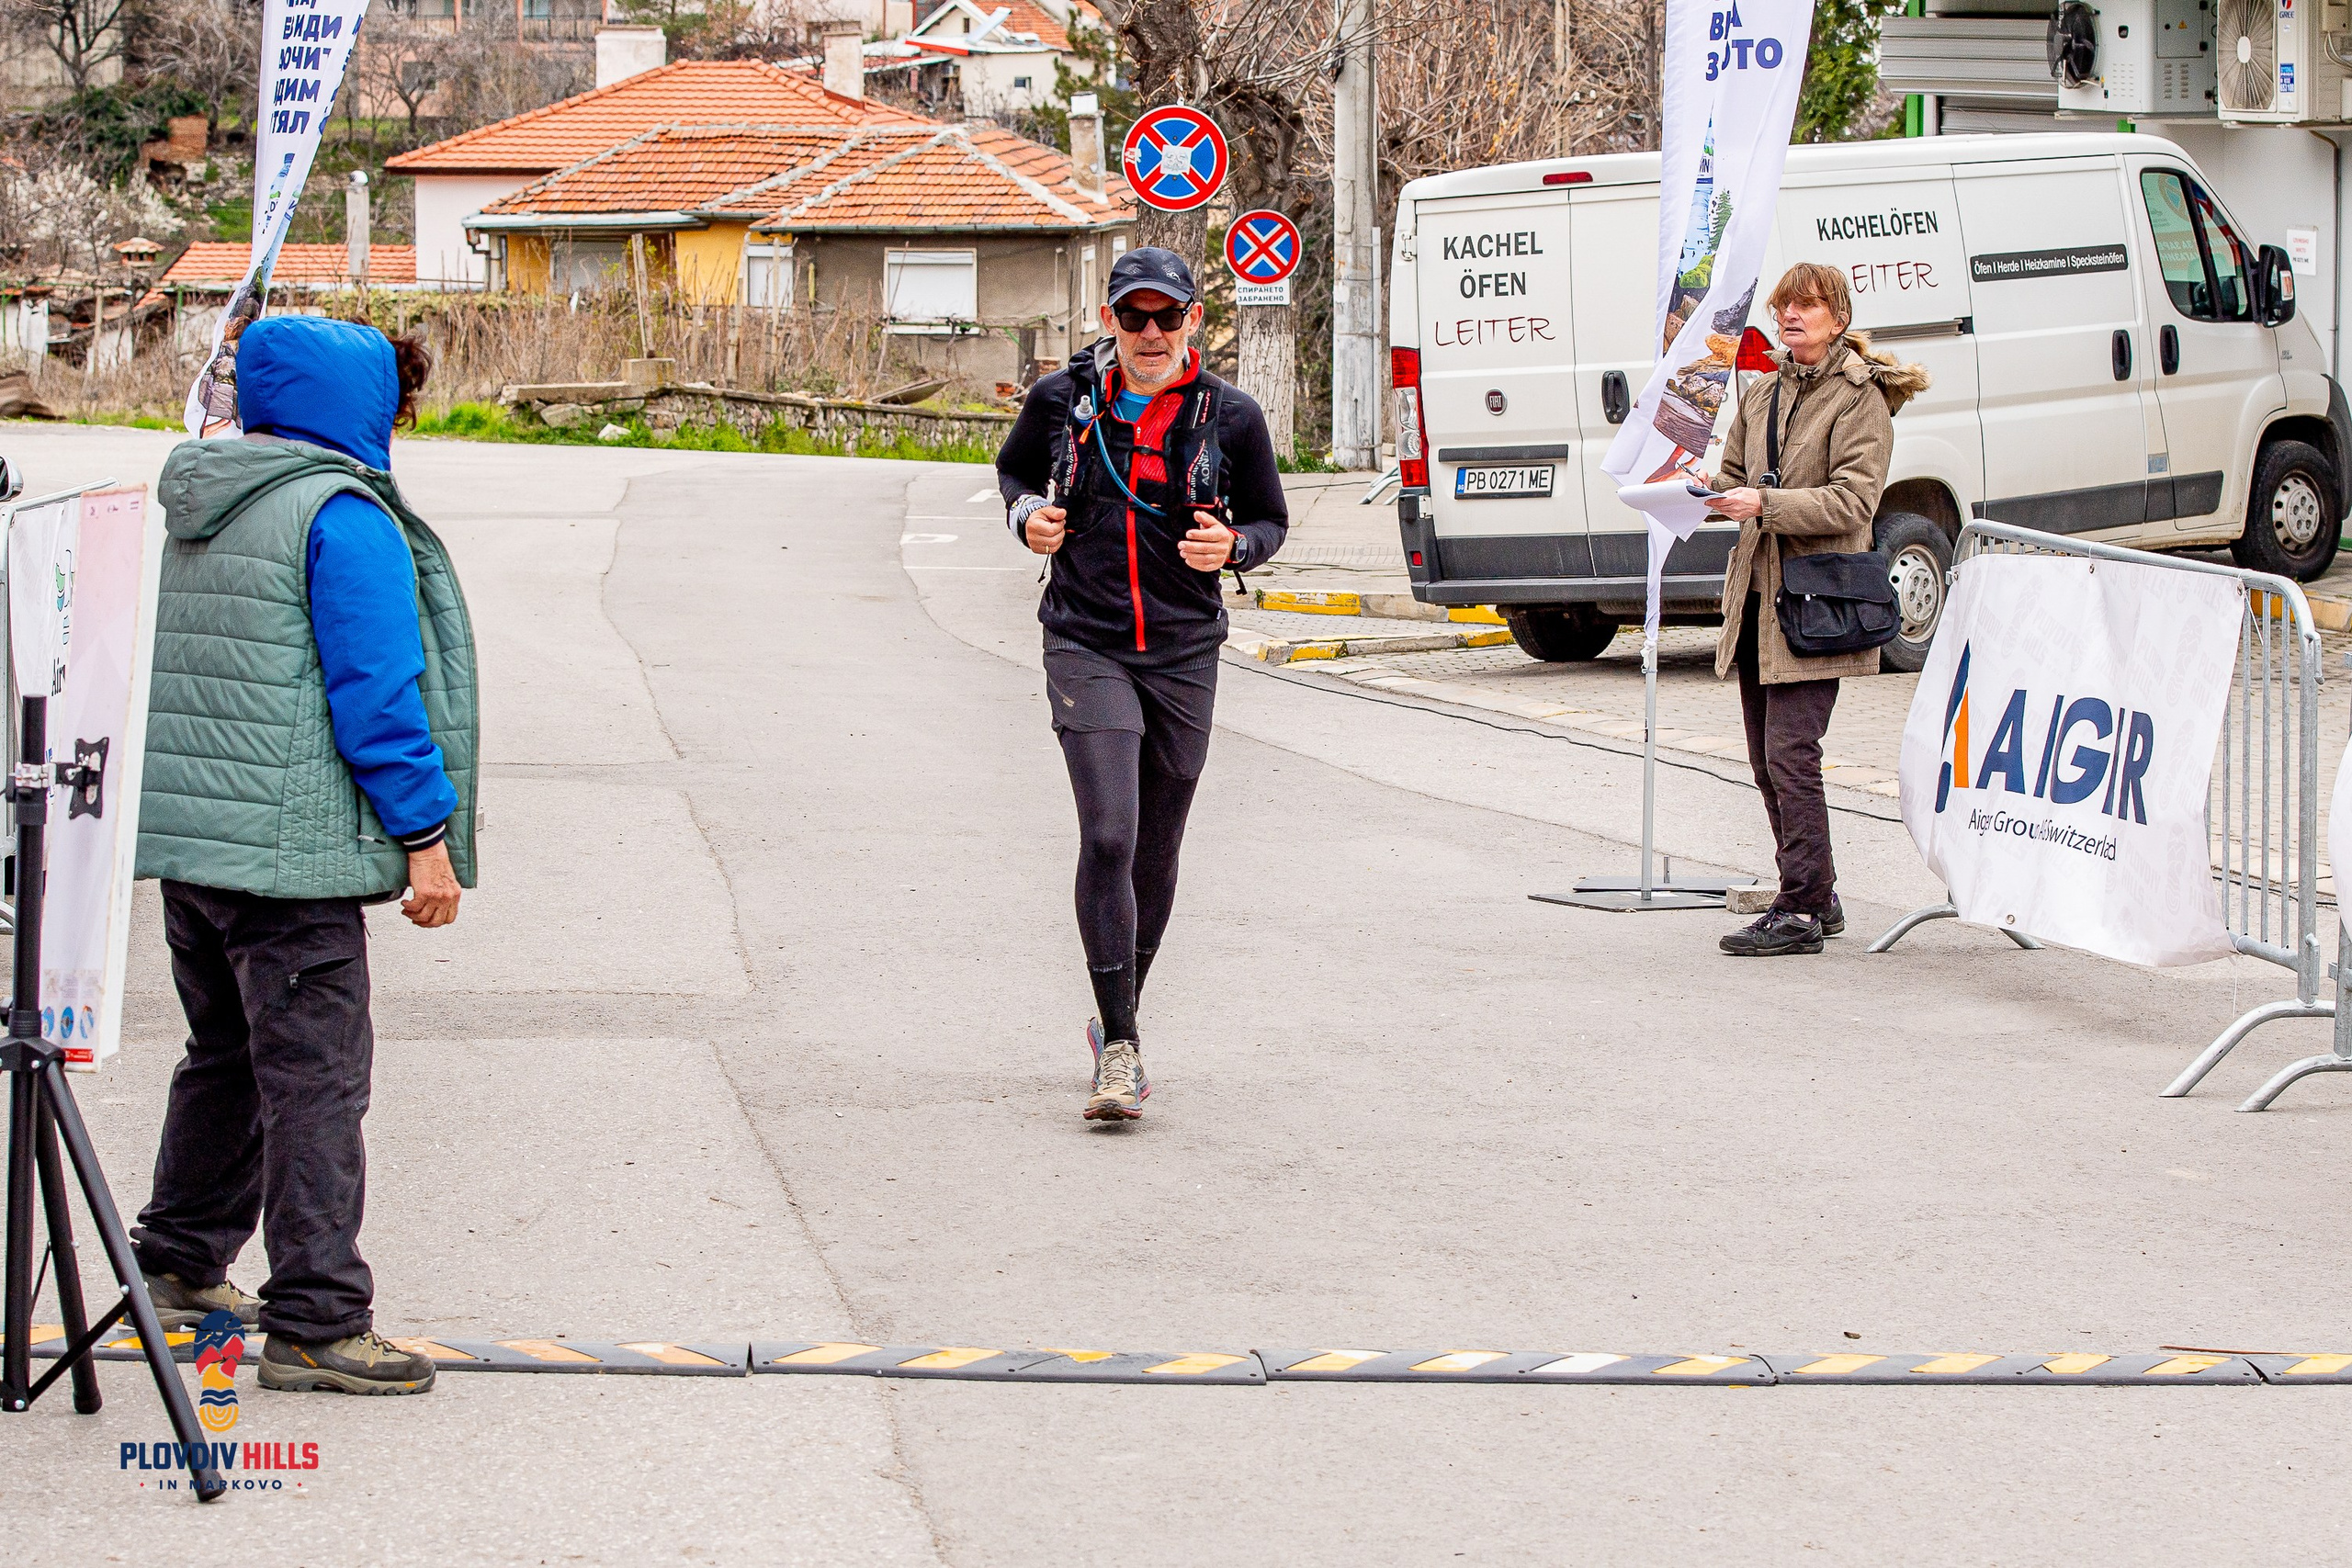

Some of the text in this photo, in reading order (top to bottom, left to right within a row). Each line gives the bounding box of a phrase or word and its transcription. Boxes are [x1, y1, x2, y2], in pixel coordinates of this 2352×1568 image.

[1816, 208, 1939, 241] KACHELÖFEN
[1443, 231, 1544, 260] KACHEL
[1849, 261, 1939, 293] EITER
[1974, 252, 2125, 275] Öfen Herde Heizkamine Specksteinöfen
[1460, 269, 1526, 299] ÖFEN
[1435, 316, 1556, 346] LEITER
[1488, 395, 1502, 408] FIAT
[1466, 471, 1487, 491] PB
[1489, 469, 1524, 490] 0271
[1528, 469, 1549, 489] ME
